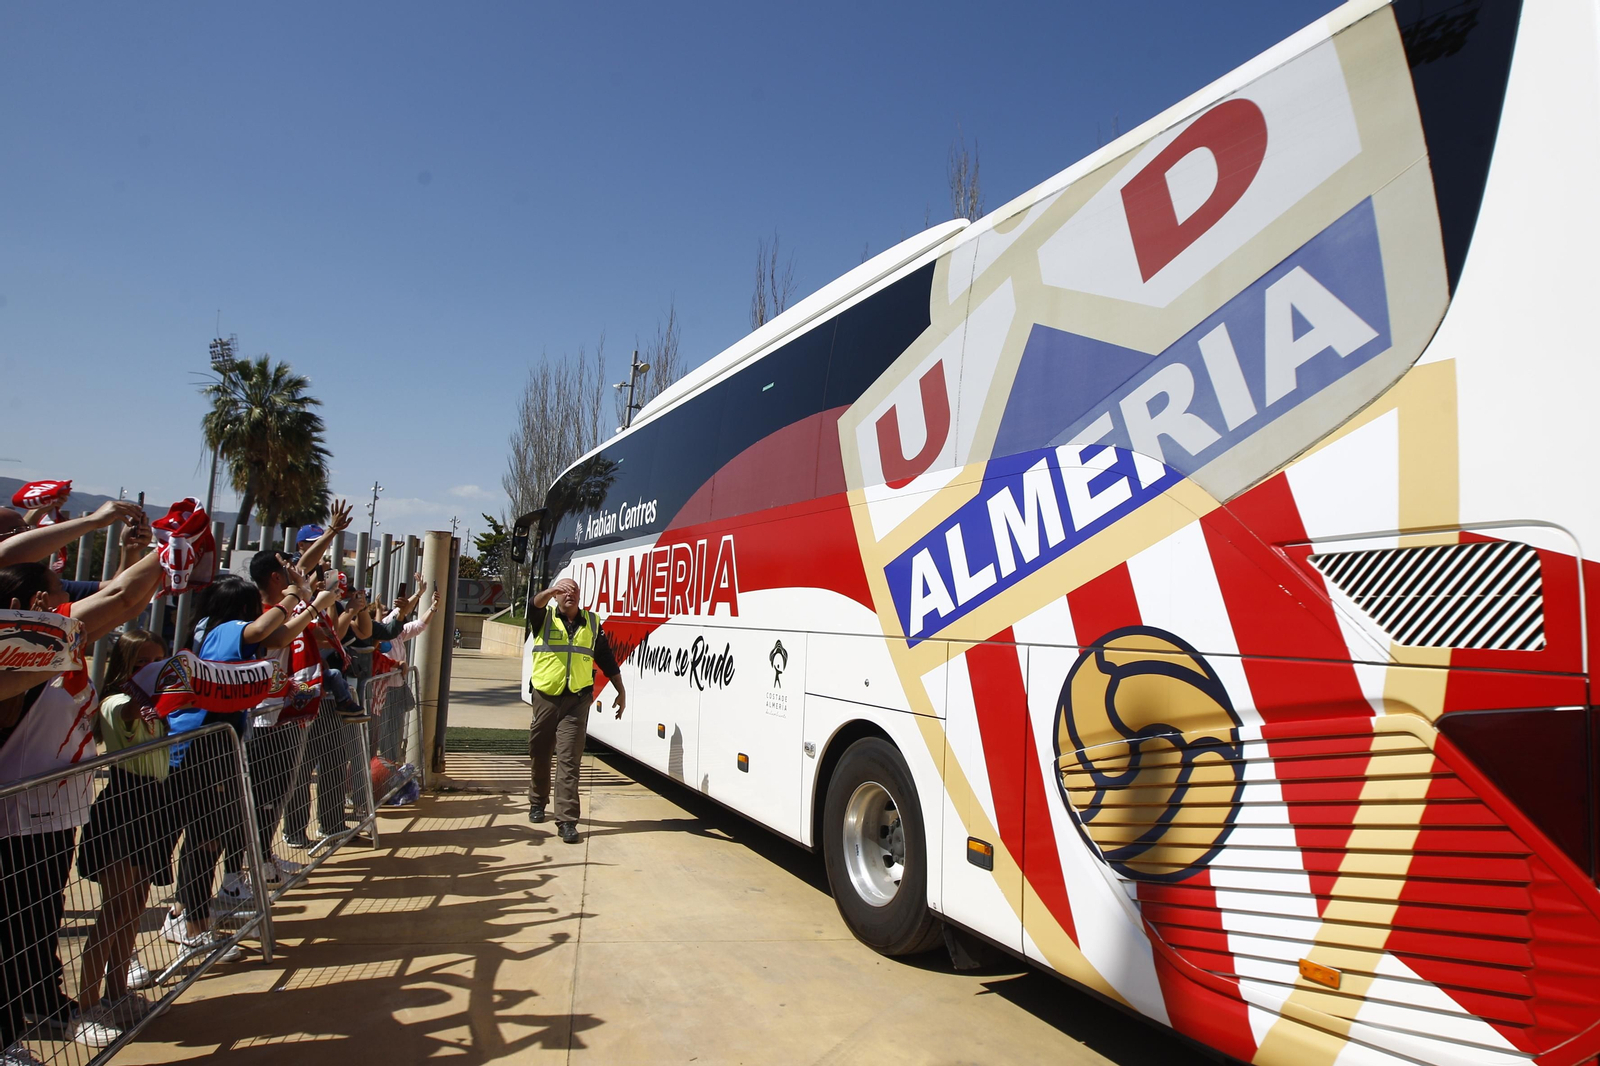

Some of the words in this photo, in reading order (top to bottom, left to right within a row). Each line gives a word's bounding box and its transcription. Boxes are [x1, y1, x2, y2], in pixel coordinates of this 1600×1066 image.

[1120, 97, 1269, 284] D
[875, 358, 951, 490] U
[908, 265, 1380, 638] ALMERIA
[584, 509, 617, 541] Arabian
[618, 496, 658, 531] Centres
[193, 660, 212, 696] UD
[214, 666, 269, 700] ALMERIA
[637, 630, 672, 679] Nunca
[674, 647, 689, 677] se
[689, 635, 736, 692] Rinde
